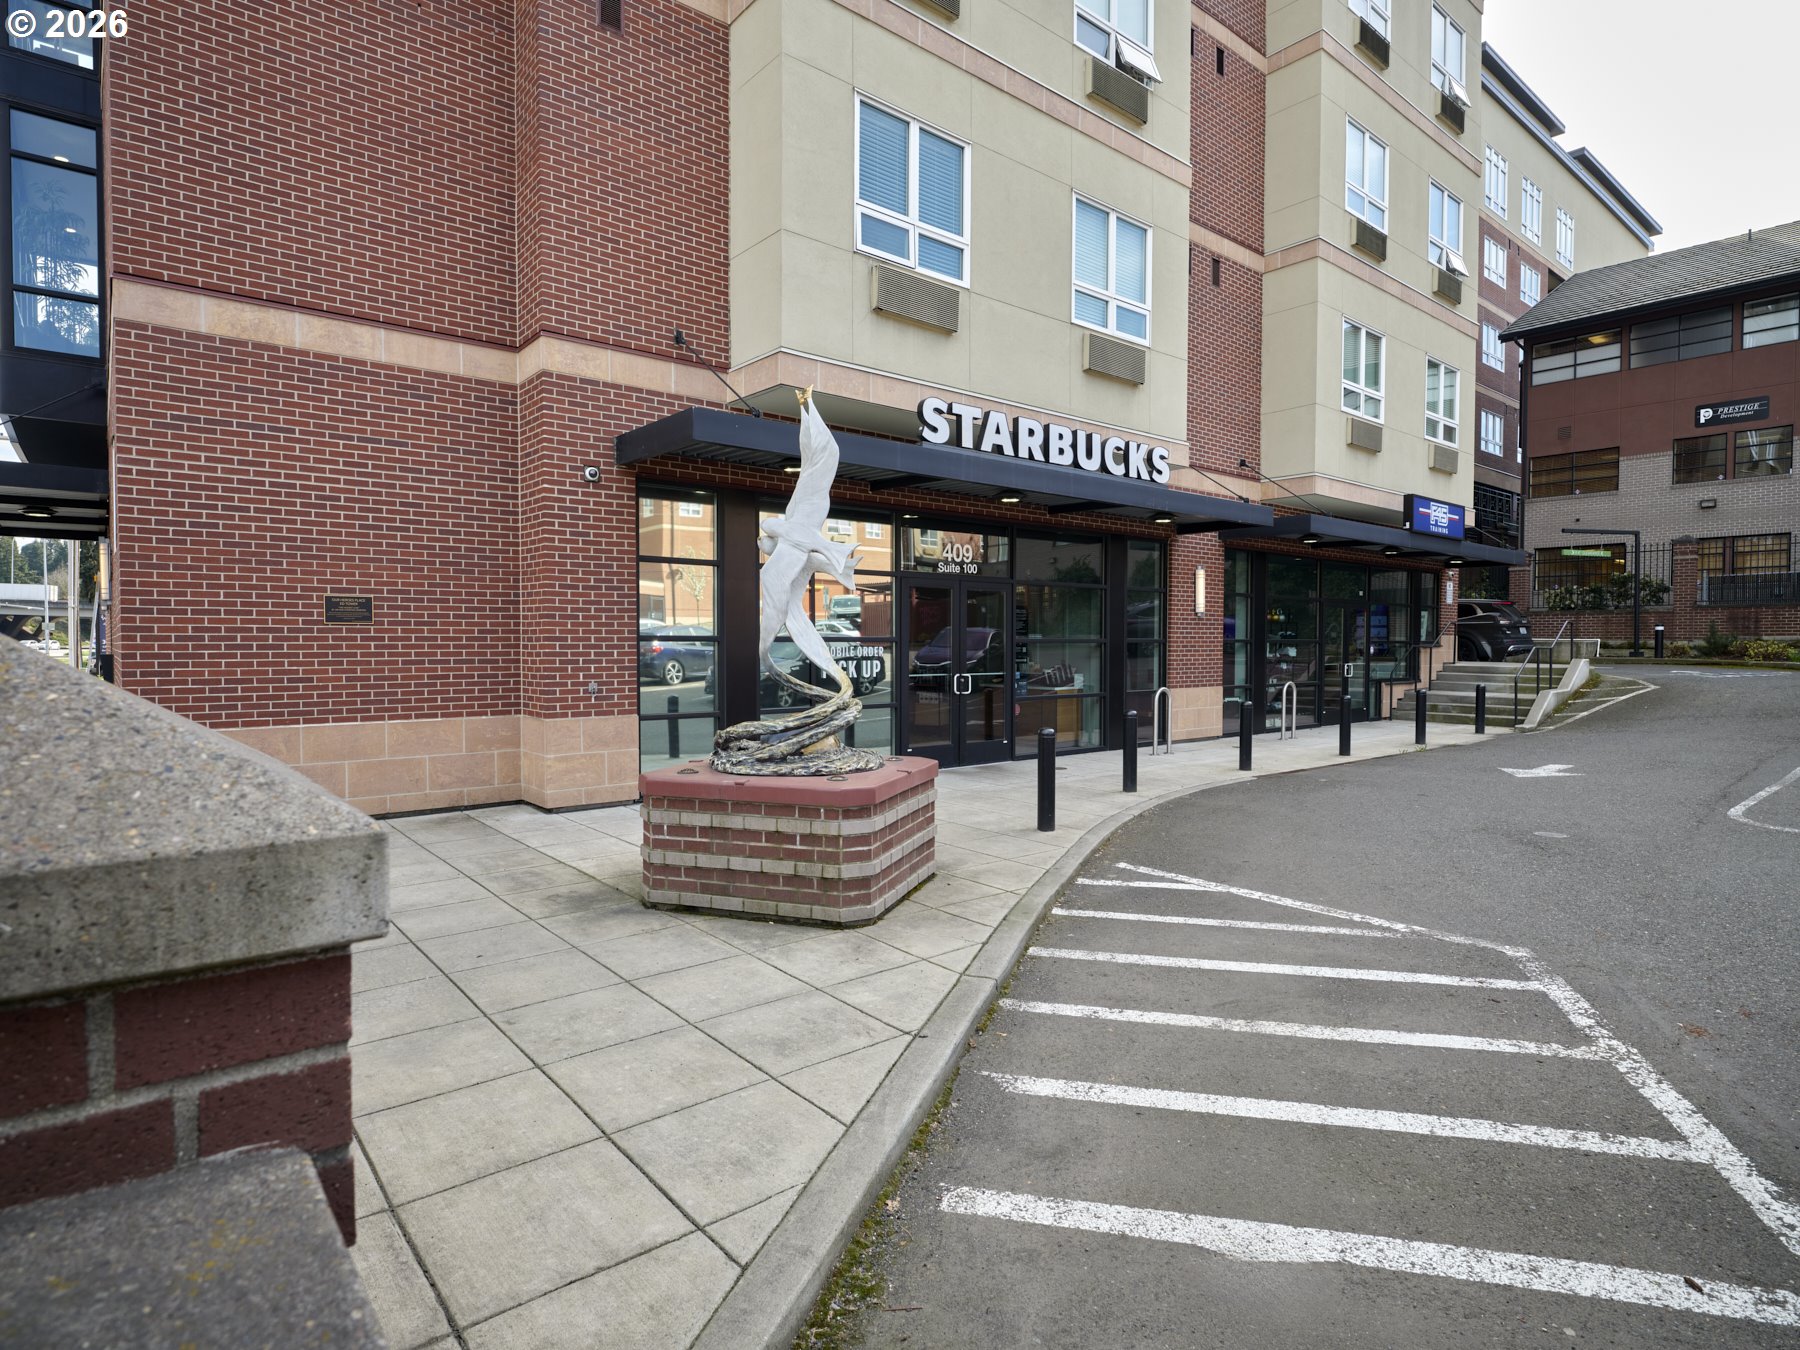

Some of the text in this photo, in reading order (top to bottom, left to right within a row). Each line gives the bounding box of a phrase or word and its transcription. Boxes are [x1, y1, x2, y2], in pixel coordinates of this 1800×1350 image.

[1717, 403, 1760, 414] PRESTIGE
[1720, 411, 1754, 419] Development
[918, 396, 1171, 484] STARBUCKS
[1430, 525, 1449, 534] TRAINING
[943, 543, 973, 563] 409
[938, 562, 978, 574] Suite 100
[829, 646, 884, 657] OBILE ORDER
[862, 660, 881, 678] UP
